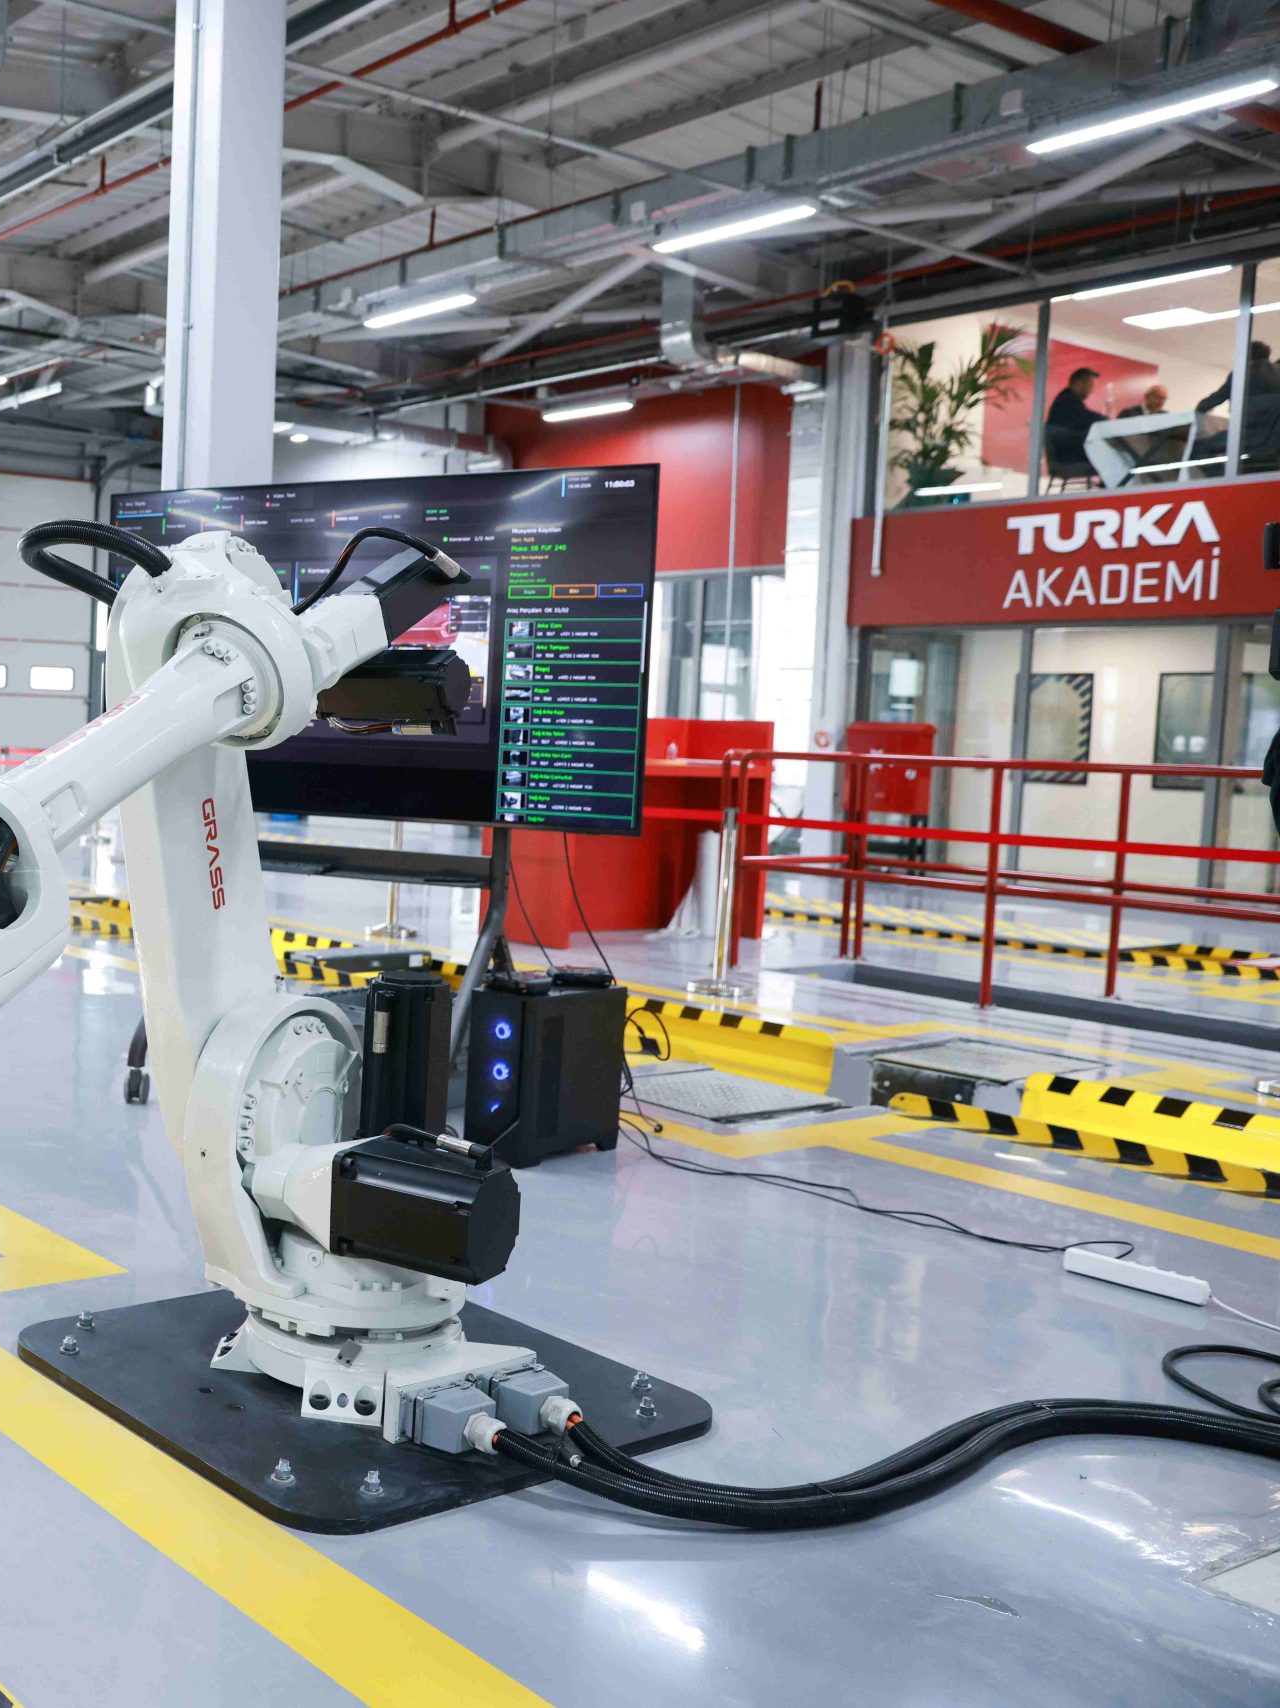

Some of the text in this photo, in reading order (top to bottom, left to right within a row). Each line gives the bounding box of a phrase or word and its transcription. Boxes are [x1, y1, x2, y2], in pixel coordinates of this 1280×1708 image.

[1007, 500, 1220, 554] TURKA
[1002, 546, 1220, 609] AKADEMİ
[202, 798, 225, 910] GRASS
